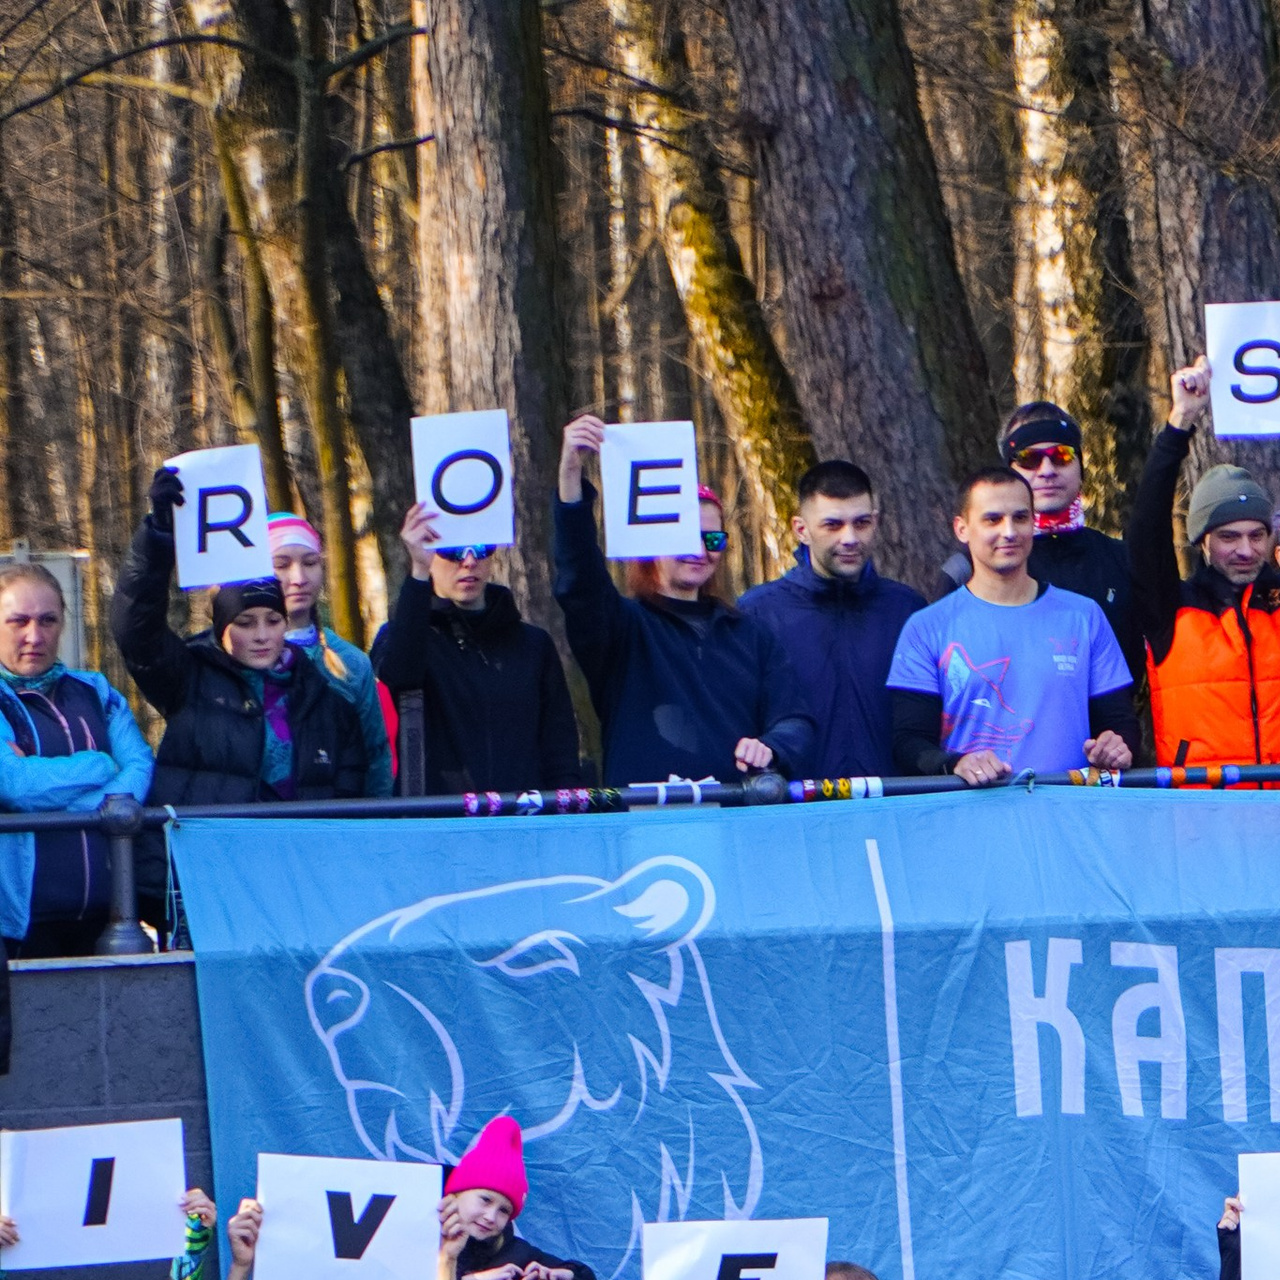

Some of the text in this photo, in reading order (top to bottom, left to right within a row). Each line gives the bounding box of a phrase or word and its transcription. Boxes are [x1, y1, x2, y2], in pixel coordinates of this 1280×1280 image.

[431, 450, 503, 515] O
[628, 459, 683, 525] E
[197, 484, 254, 554] R
[82, 1157, 116, 1226] I
[325, 1190, 396, 1260] V
